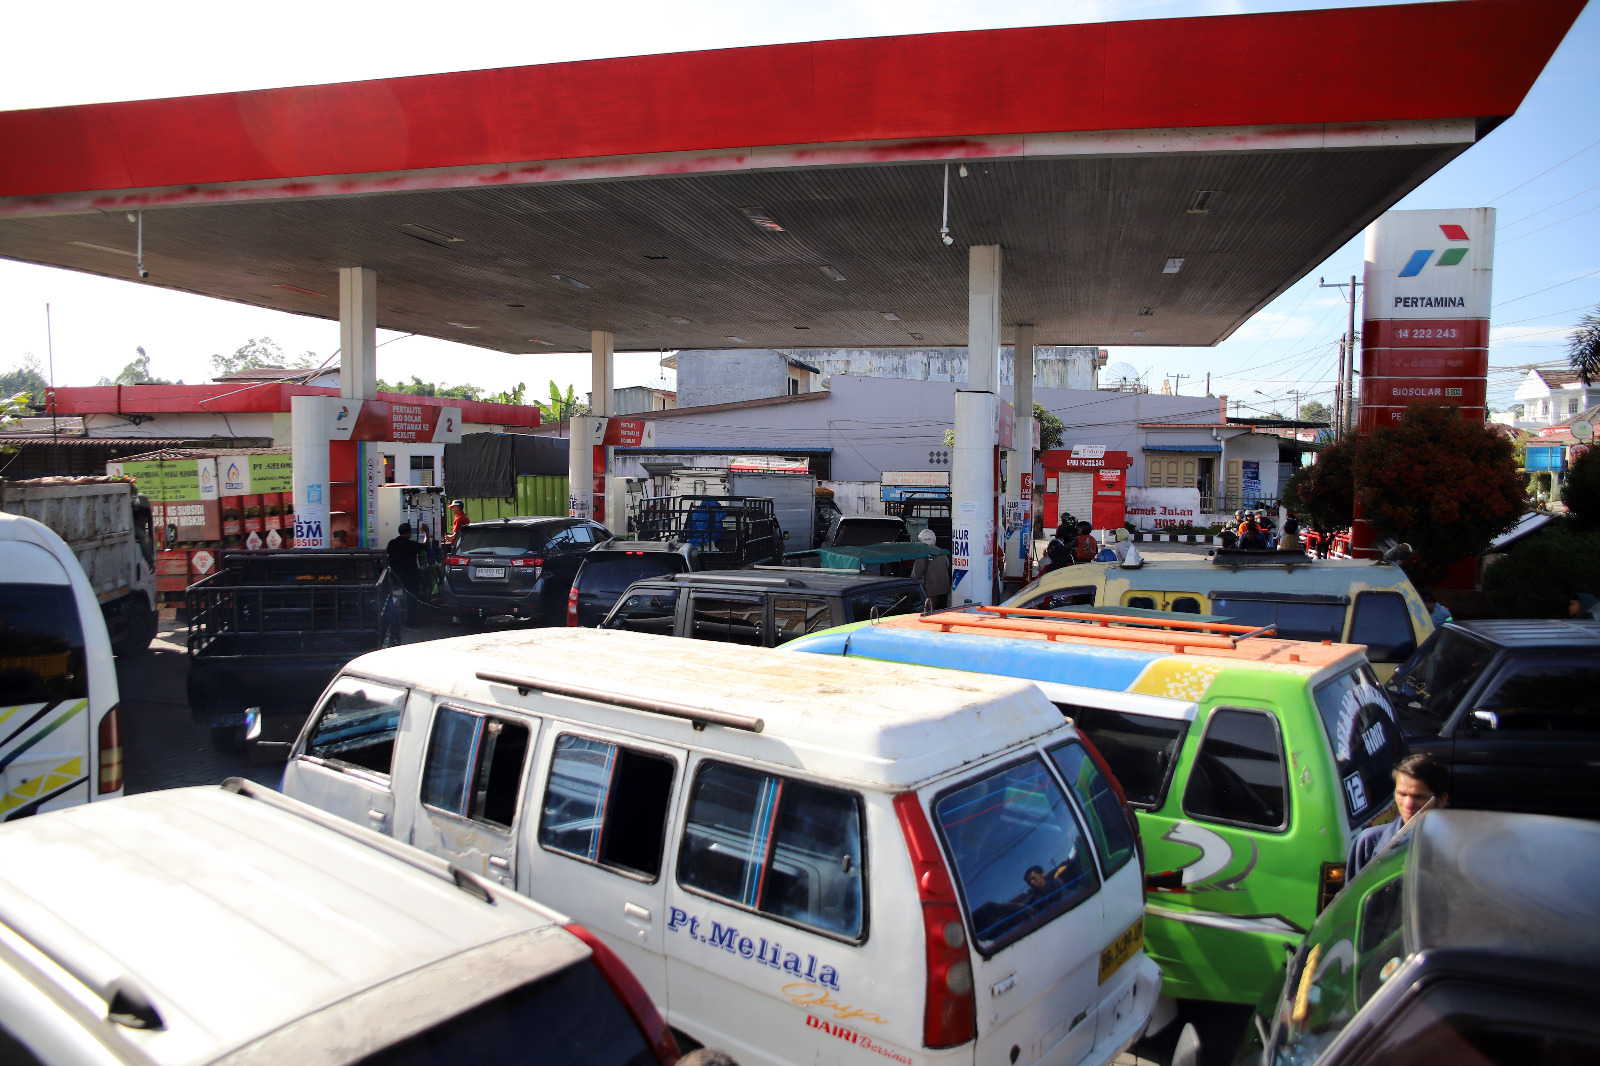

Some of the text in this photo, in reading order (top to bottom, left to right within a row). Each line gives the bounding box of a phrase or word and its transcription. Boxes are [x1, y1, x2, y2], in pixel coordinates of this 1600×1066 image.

[1394, 296, 1465, 308] PERTAMINA
[1398, 329, 1456, 338] 14 222 243
[1392, 388, 1441, 396] BIOSOLAR
[393, 406, 421, 415] PERTALITE
[393, 414, 421, 423] BIO SOLAR
[1391, 412, 1404, 421] PE
[393, 422, 430, 431] PERTAMAX 92
[447, 418, 453, 432] 2
[393, 431, 416, 439] DEXLITE
[177, 504, 205, 516] SUBSIDI
[1346, 775, 1367, 811] 12
[805, 1014, 914, 1066] DAIRI Bersinar
